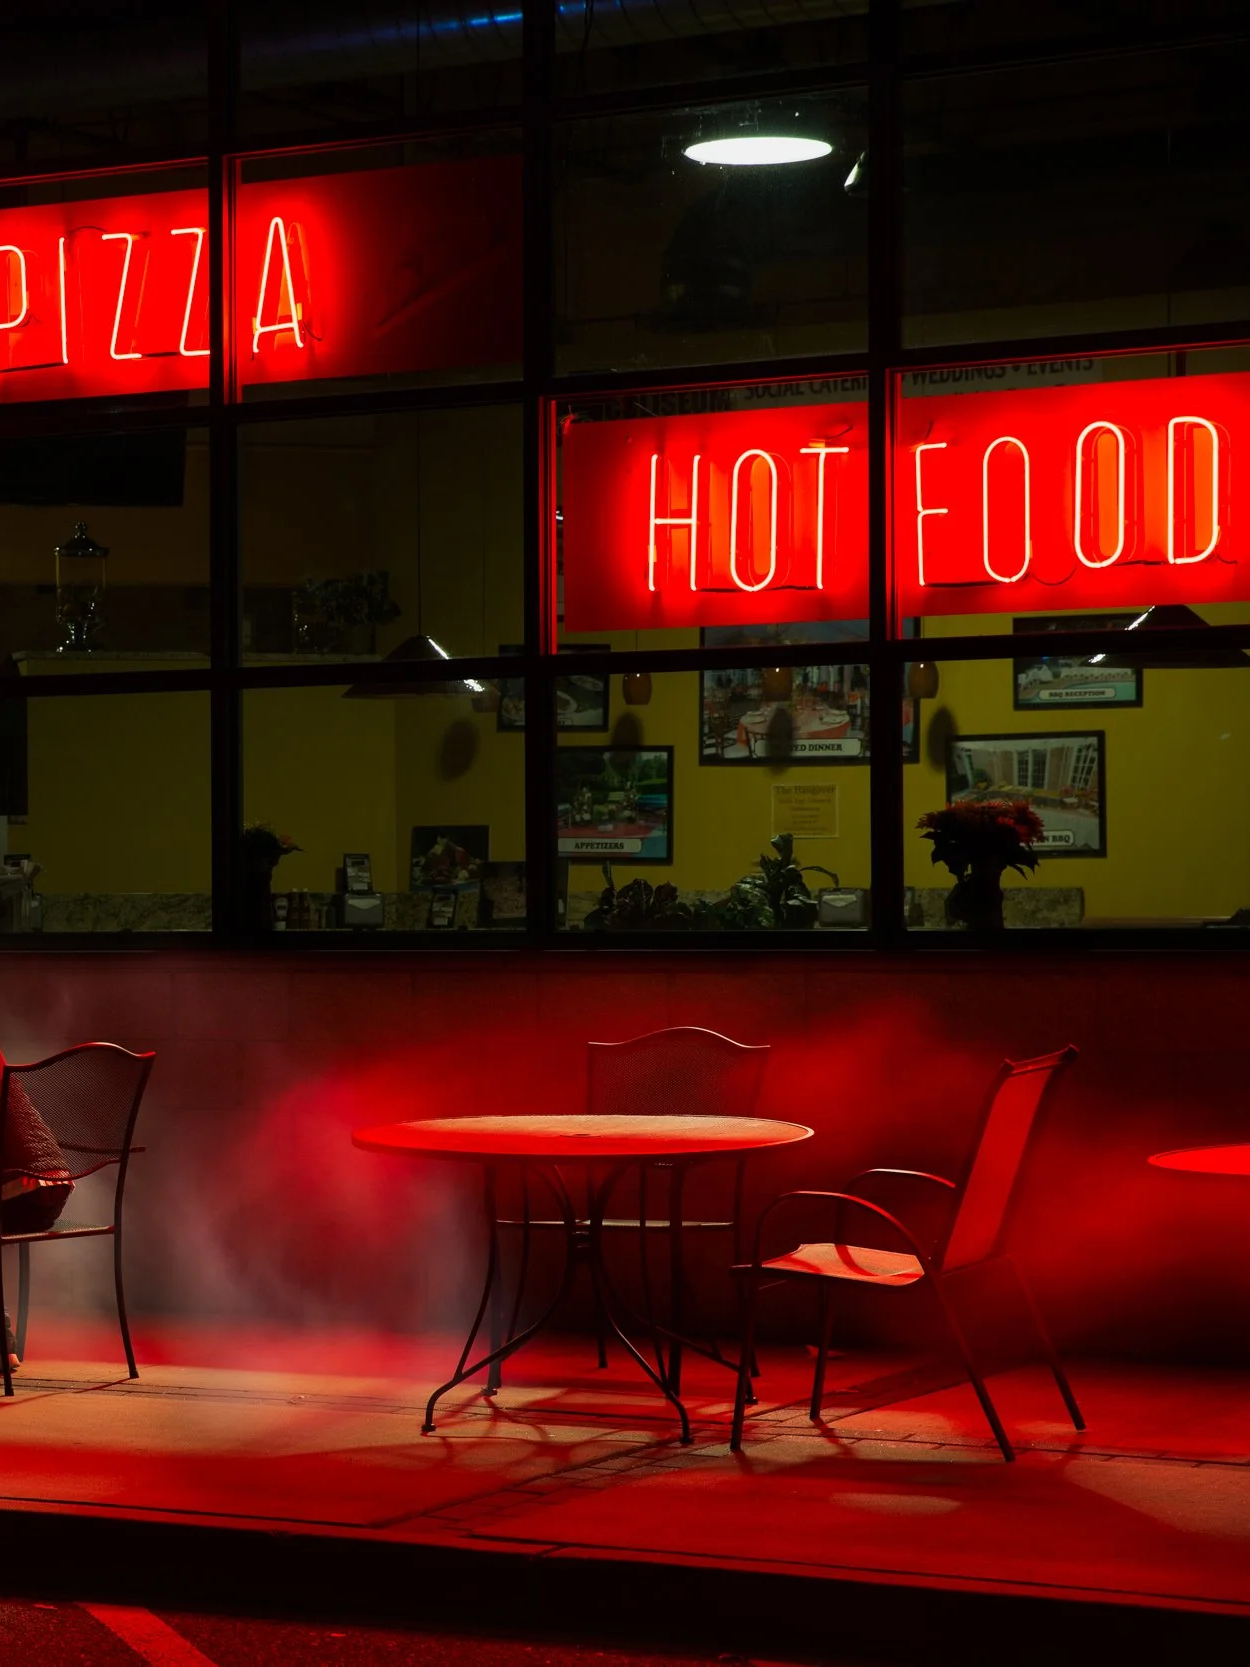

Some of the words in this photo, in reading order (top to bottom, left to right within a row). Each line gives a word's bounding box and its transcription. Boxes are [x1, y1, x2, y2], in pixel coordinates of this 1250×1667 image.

[744, 381, 804, 400] SOCIAL
[810, 376, 867, 395] CATERI
[912, 364, 1006, 385] WEDDINGS
[1027, 359, 1094, 376] EVENTS
[647, 444, 850, 593] HOT
[913, 415, 1221, 587] FOOD
[1065, 690, 1106, 698] RECEPTION
[808, 743, 842, 751] DINNER
[1052, 834, 1071, 843] BBQ
[573, 841, 625, 850] APPETIZERS
